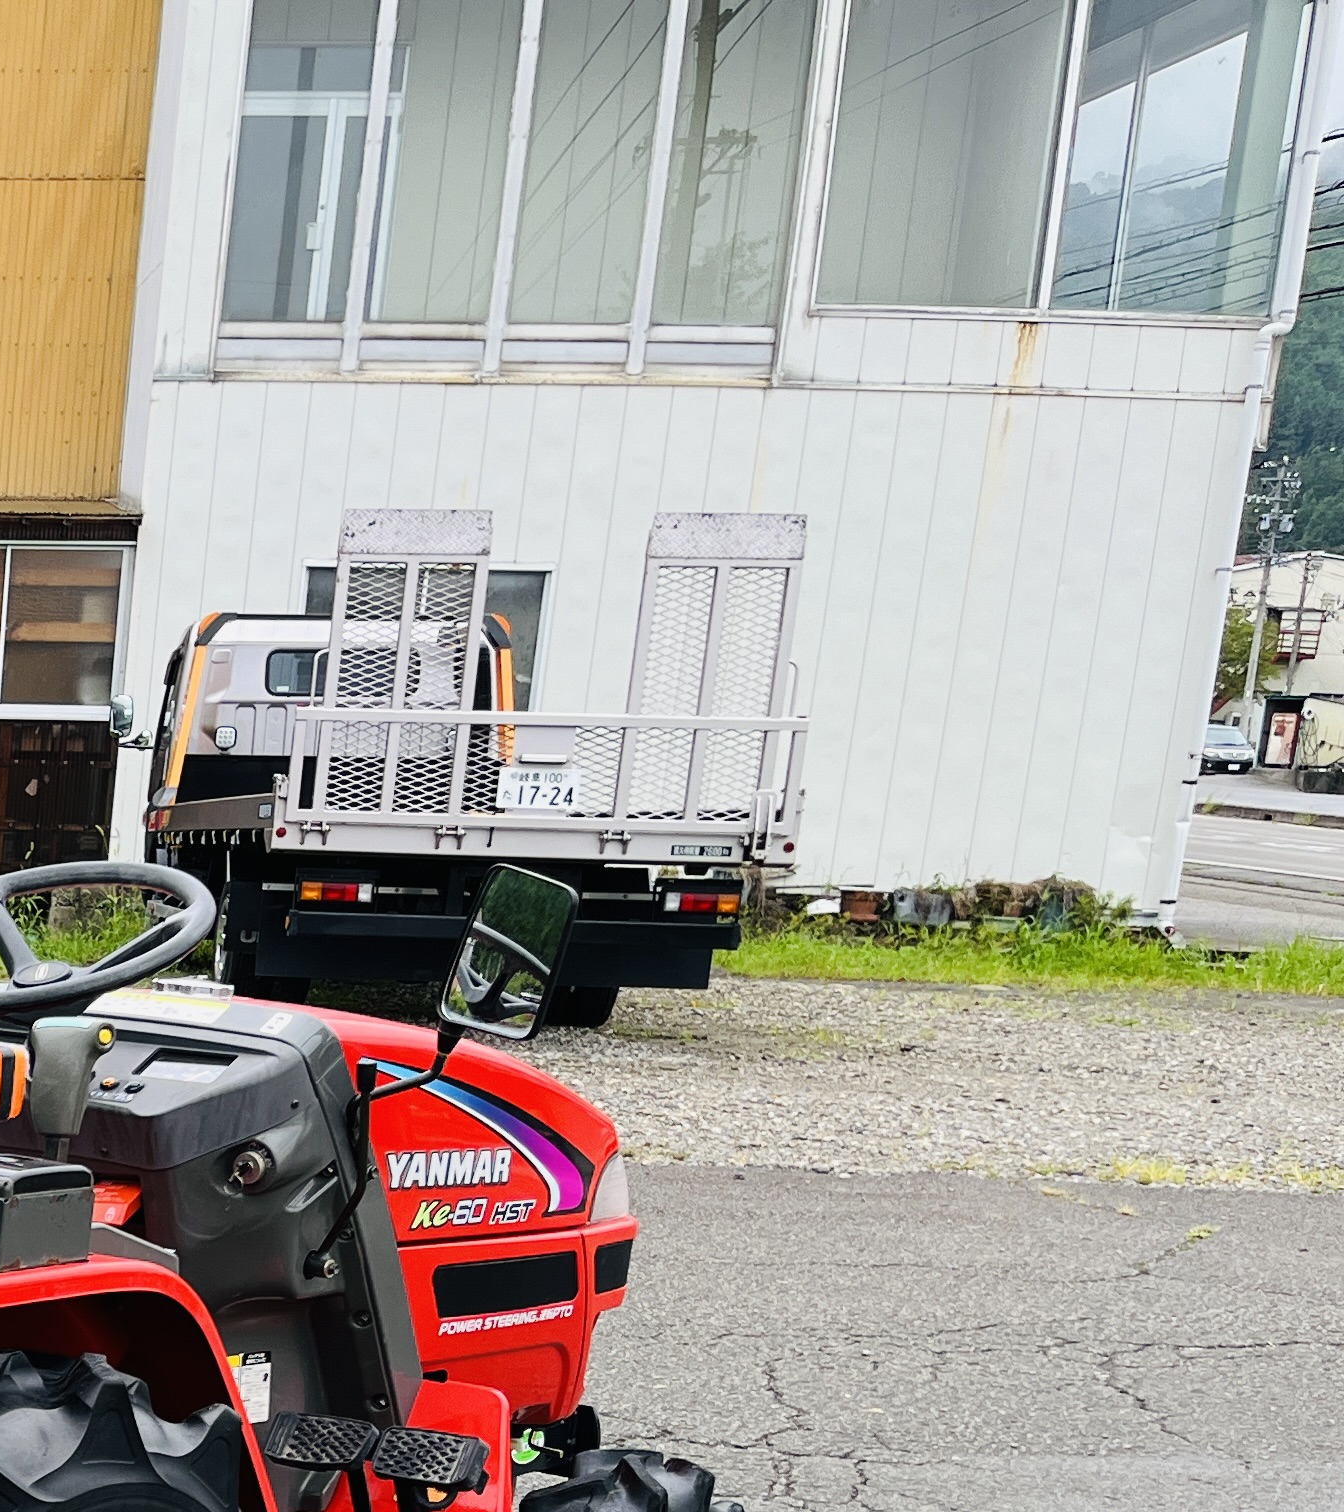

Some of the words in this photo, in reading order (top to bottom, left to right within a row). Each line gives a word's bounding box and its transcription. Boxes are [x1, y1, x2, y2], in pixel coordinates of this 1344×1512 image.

[544, 772, 563, 783] 100
[518, 785, 574, 806] 17-24
[386, 1149, 512, 1191] YANMAR
[409, 1196, 489, 1231] Ke-60
[489, 1198, 538, 1226] HST
[438, 1318, 483, 1336] POWER
